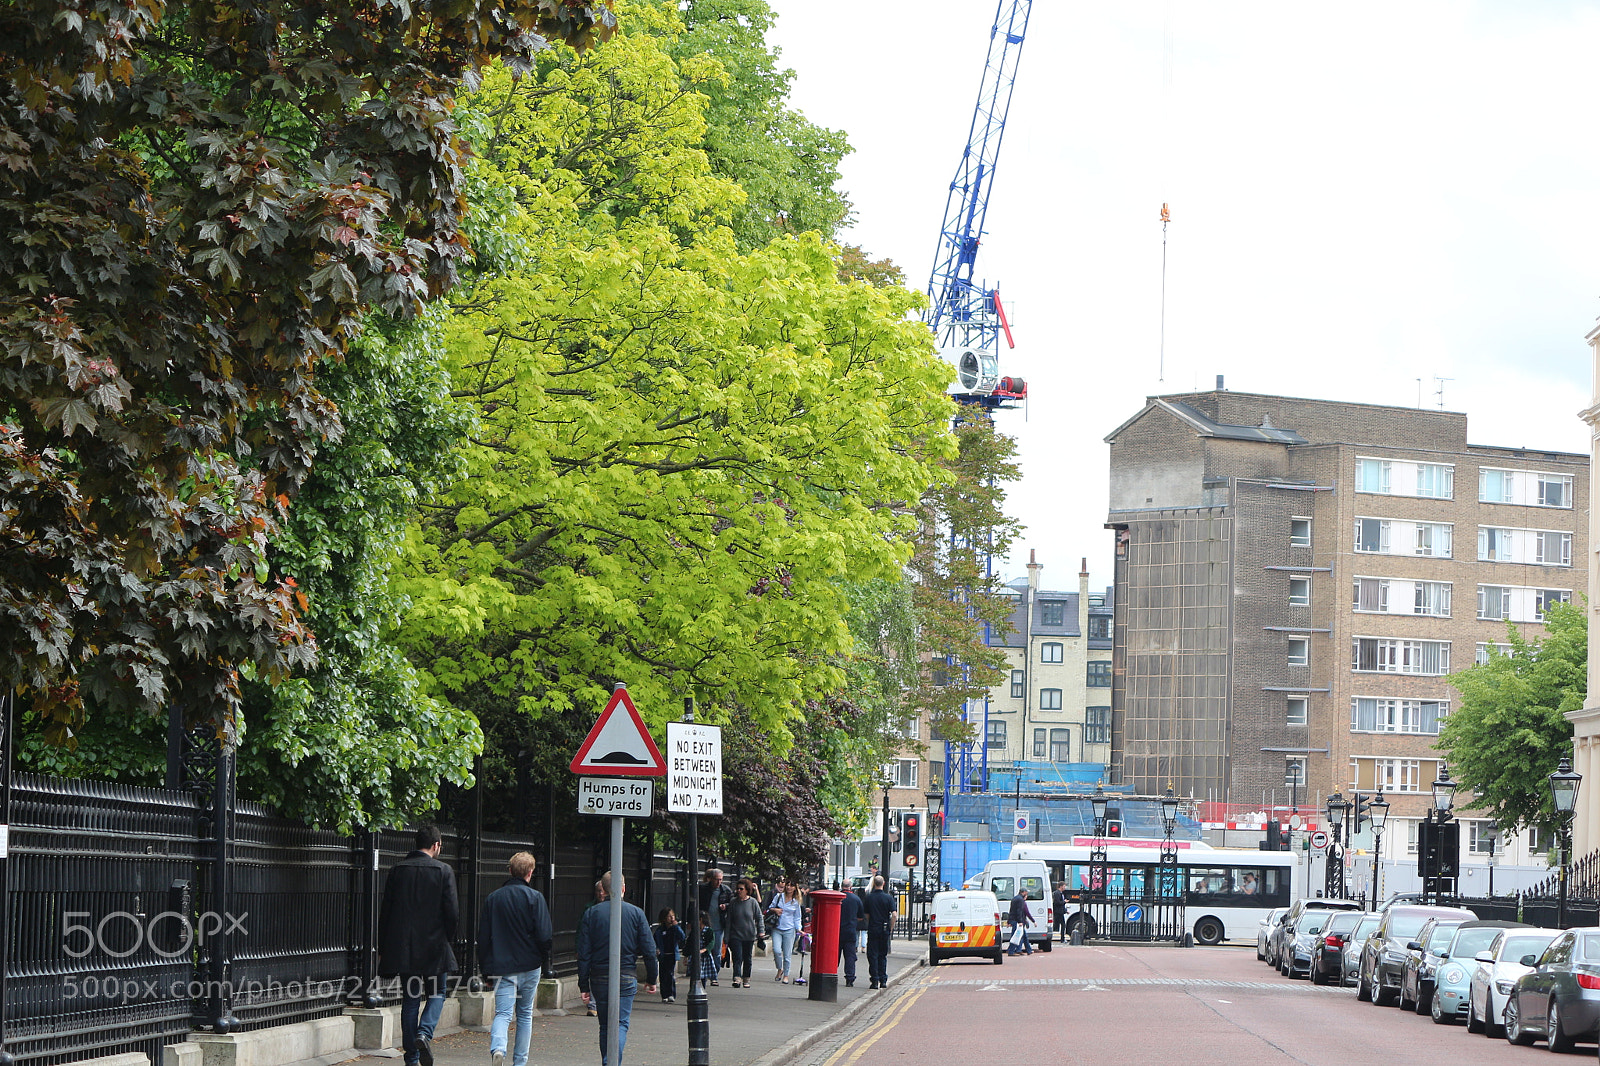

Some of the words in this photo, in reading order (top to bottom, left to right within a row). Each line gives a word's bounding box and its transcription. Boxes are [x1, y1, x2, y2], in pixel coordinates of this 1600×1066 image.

[677, 741, 689, 753] NO
[693, 741, 713, 755] EXIT
[674, 758, 716, 774] BETWEEN
[583, 781, 626, 796] Humps
[630, 784, 648, 796] for
[673, 775, 717, 790] MIDNIGHT
[587, 797, 604, 809] 50
[608, 799, 642, 811] yards
[672, 793, 692, 807] AND
